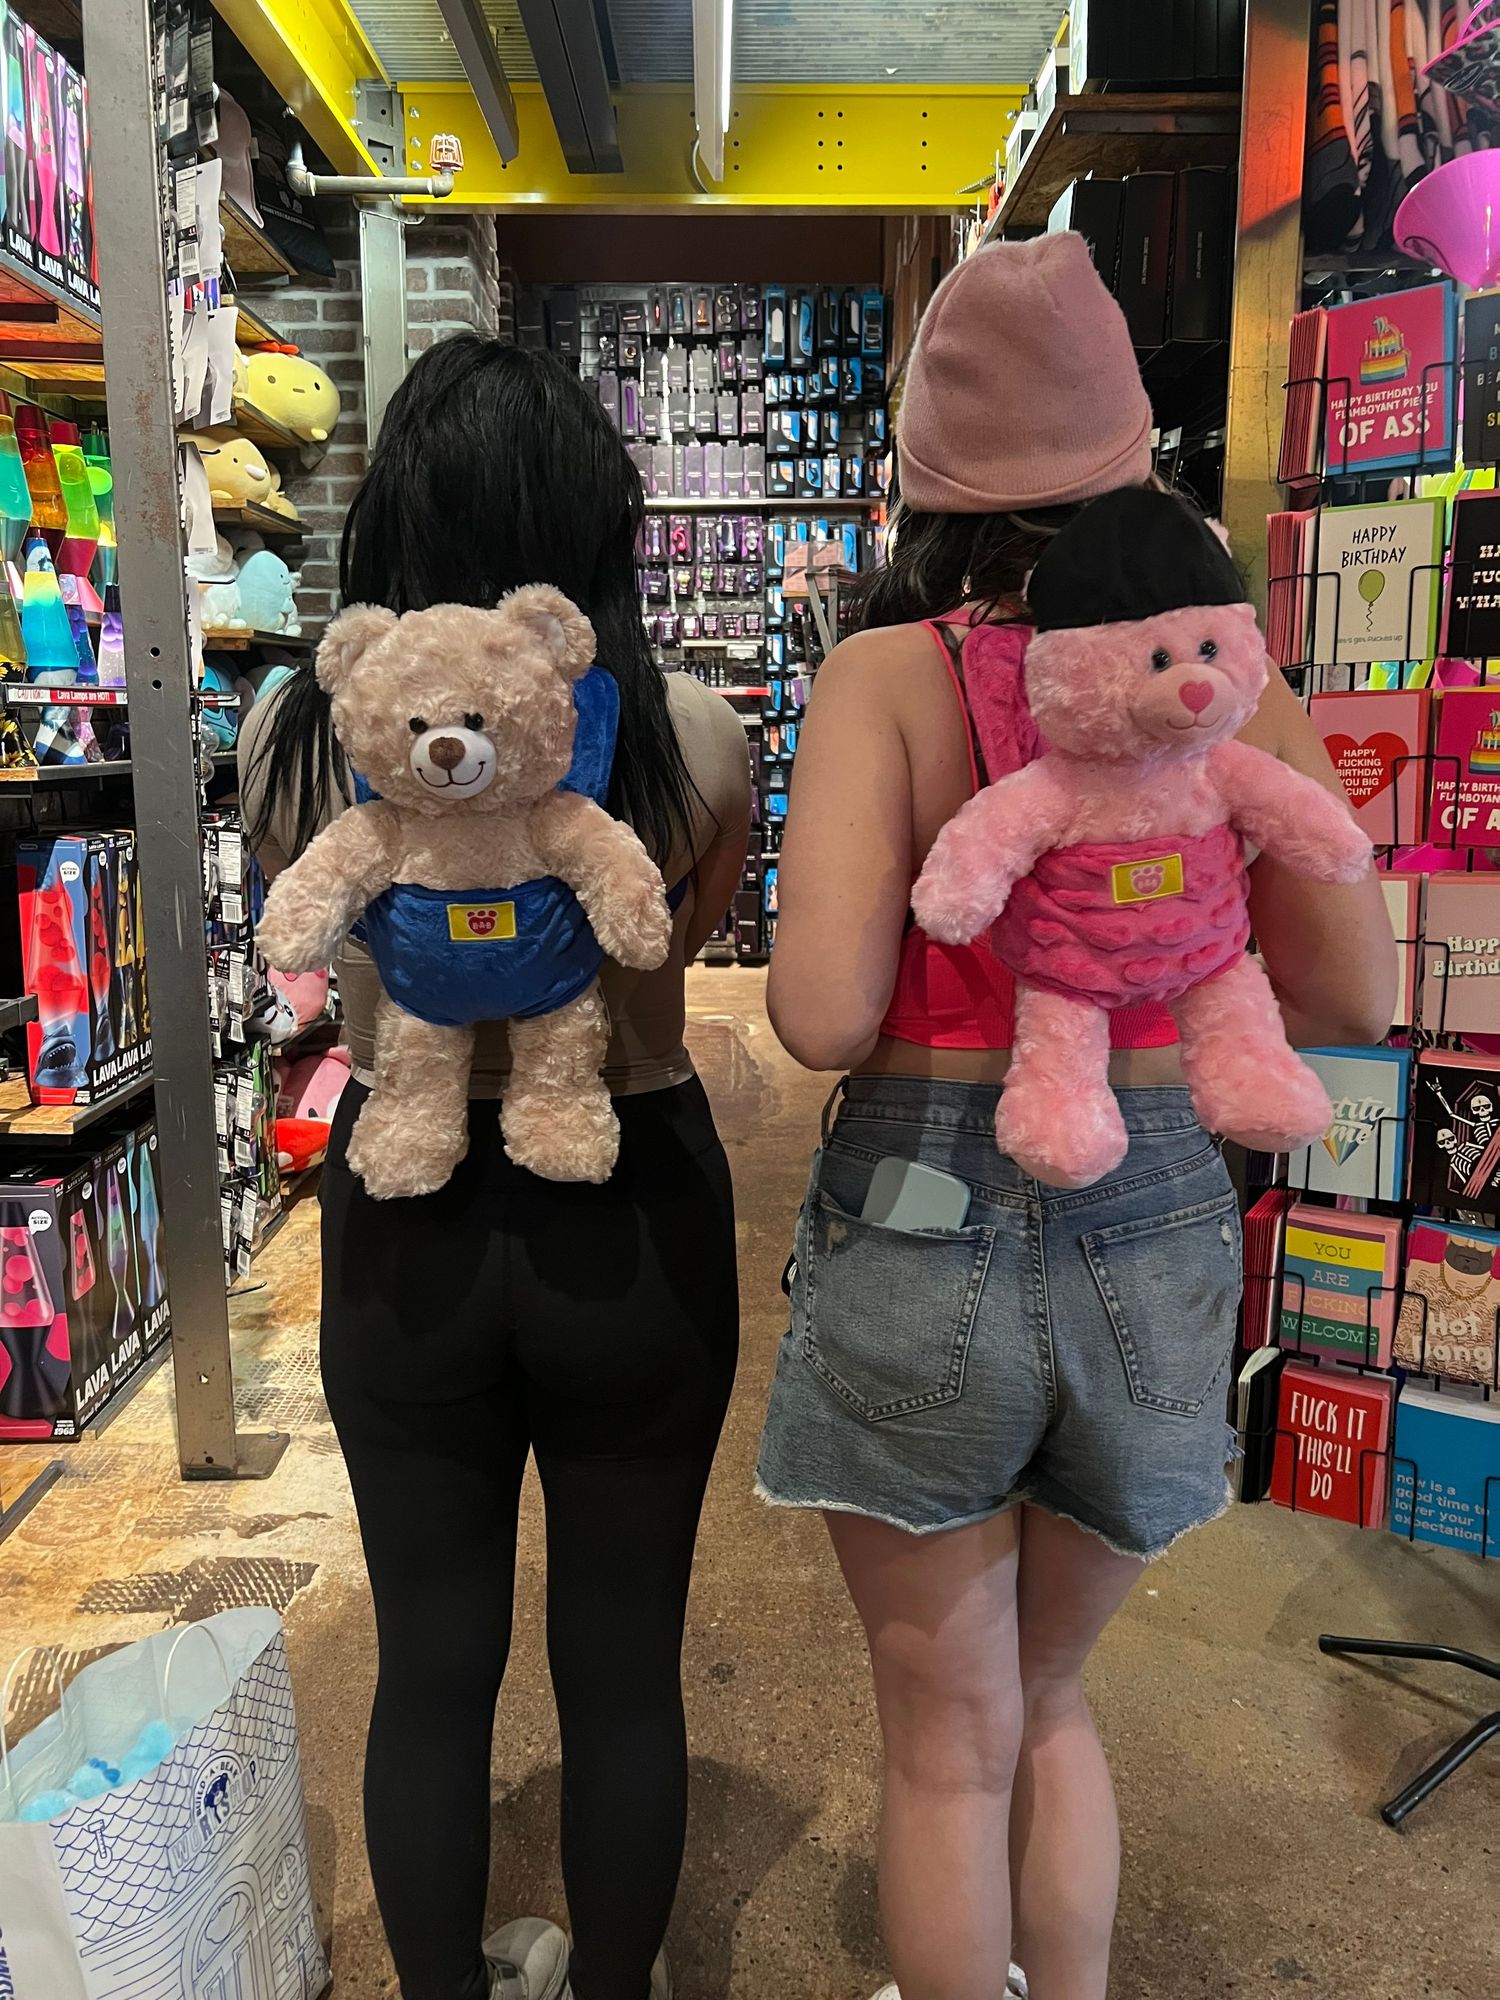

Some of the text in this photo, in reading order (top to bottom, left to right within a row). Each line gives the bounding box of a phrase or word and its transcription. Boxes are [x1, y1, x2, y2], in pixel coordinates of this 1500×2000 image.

[9, 228, 33, 263] LAVA
[38, 251, 64, 282] LAVA
[67, 269, 89, 299] LAVA
[1365, 386, 1414, 404] BIRTHDAY
[1416, 382, 1438, 395] YOU
[1335, 400, 1401, 420] FLAMBOYANT
[1339, 409, 1430, 447] OF ASS
[1352, 524, 1397, 544] HAPPY
[1342, 546, 1407, 568] BIRTHDAY
[1338, 758, 1381, 767] FUCKING
[1343, 749, 1376, 757] HAPPY
[1336, 768, 1384, 777] BIRTHDAY
[1340, 777, 1379, 786] YOU BIG
[1346, 787, 1372, 796] CUNT
[1441, 805, 1479, 829] OF
[1447, 936, 1499, 954] Happ
[117, 1047, 139, 1073] LAVA
[93, 1060, 117, 1087] LAVA
[1313, 1242, 1351, 1260] YOU
[1312, 1269, 1350, 1287] ARE
[144, 1299, 170, 1340] LAVA
[1281, 1315, 1378, 1346] WELCOME
[111, 1330, 140, 1374] LAVA
[76, 1362, 110, 1411] LAVA
[1290, 1391, 1368, 1441] FUCK IT
[1297, 1432, 1352, 1474] THIS'LL
[1310, 1469, 1333, 1500] DO
[1396, 1474, 1456, 1496] now is a
[1395, 1498, 1474, 1526] lower your
[1396, 1487, 1490, 1516] good time to
